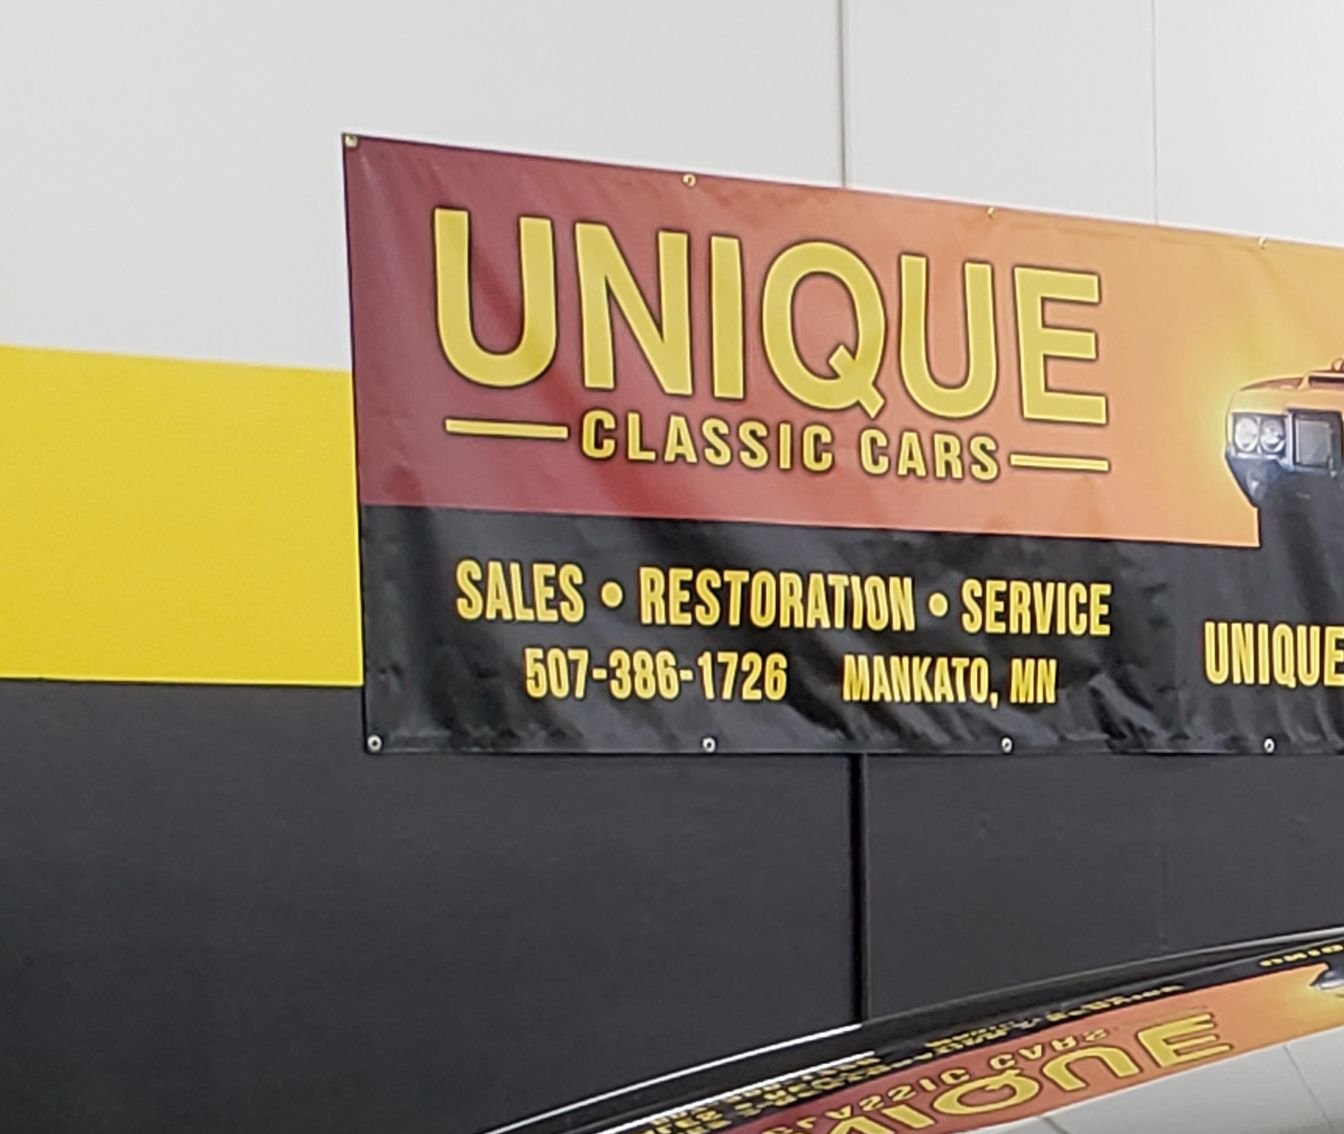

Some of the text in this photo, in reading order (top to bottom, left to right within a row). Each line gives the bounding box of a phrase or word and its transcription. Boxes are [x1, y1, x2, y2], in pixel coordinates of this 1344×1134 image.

[433, 207, 1108, 425] UNIQUE
[581, 408, 1000, 481] CLASSIC CARS
[455, 559, 1112, 635] SALES RESTORATION SERVICE
[525, 647, 1057, 708] 507-386-1726 MANKATO, MN
